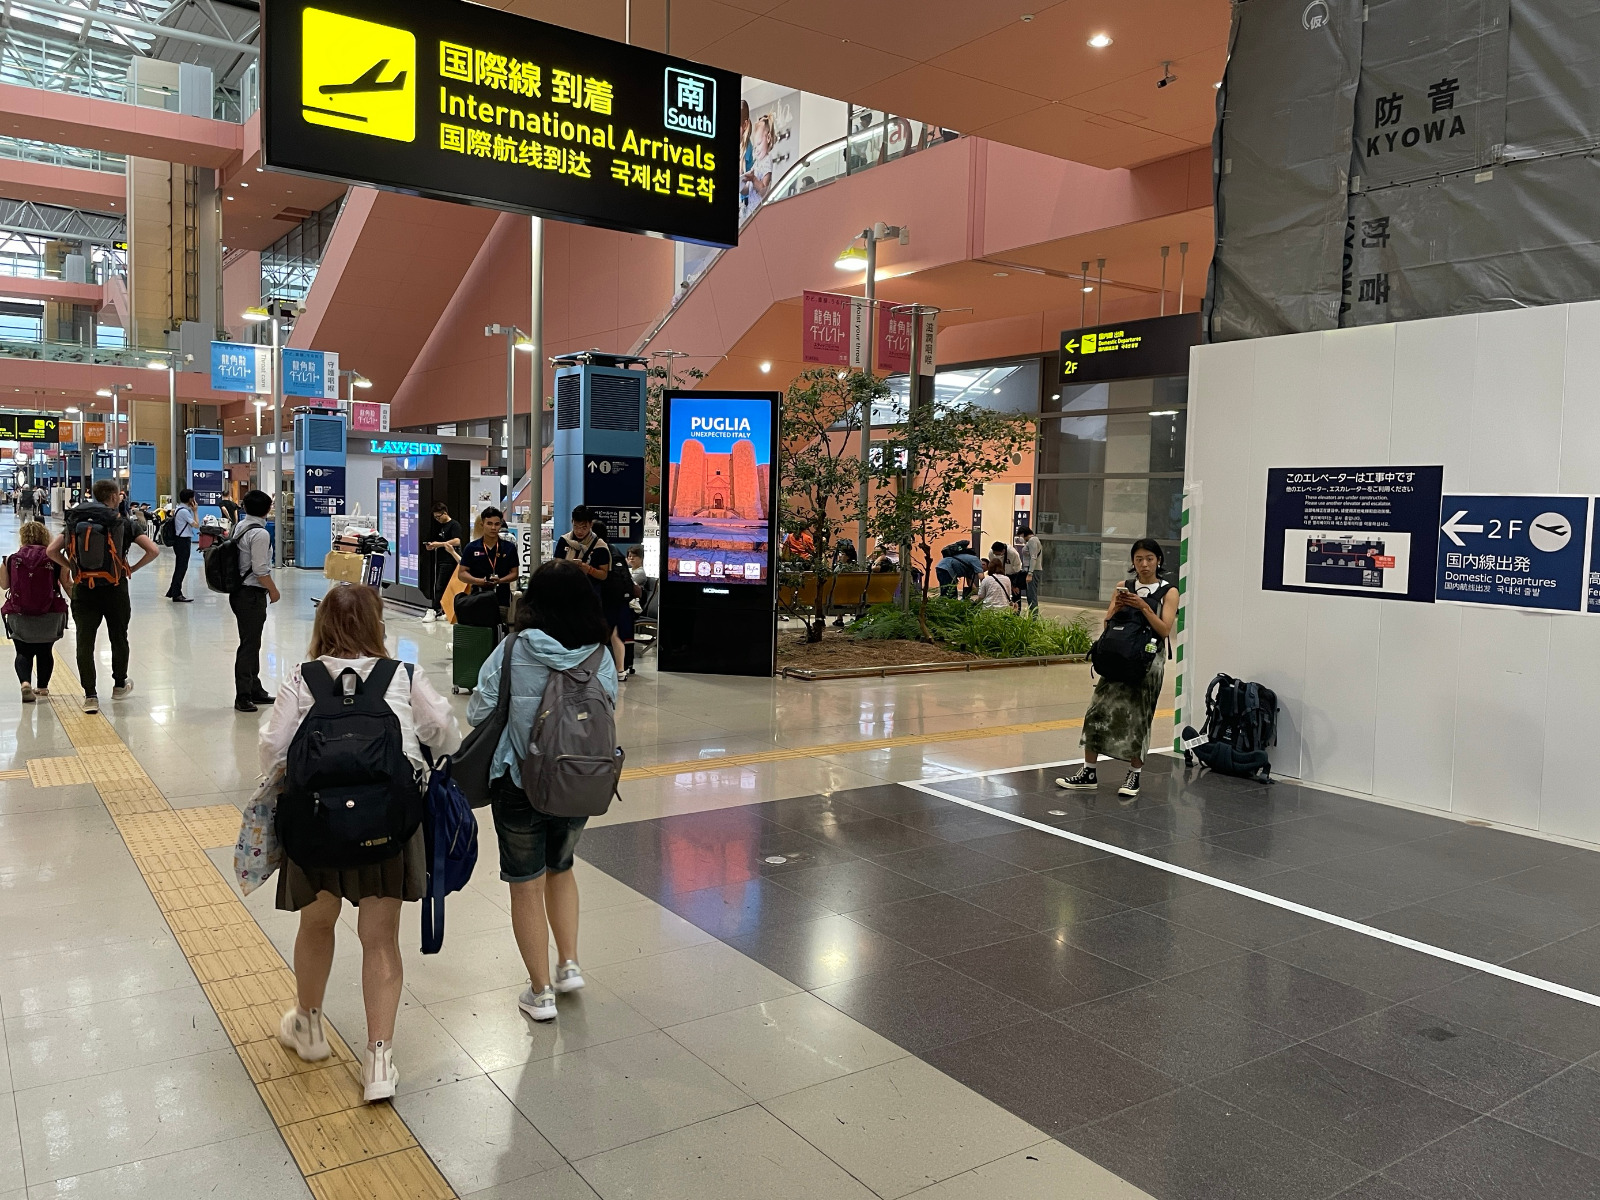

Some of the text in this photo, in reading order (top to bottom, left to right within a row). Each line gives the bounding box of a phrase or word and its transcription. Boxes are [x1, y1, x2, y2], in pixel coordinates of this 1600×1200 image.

[439, 40, 614, 116] 国際線 到着
[677, 75, 706, 110] 南
[439, 87, 716, 172] International Arrivals
[667, 107, 713, 133] South
[1366, 114, 1467, 158] KYOWA
[610, 158, 716, 204] 국제선 도착
[1064, 361, 1078, 374] 2F
[691, 416, 751, 431] PUGLIA
[370, 440, 442, 455] LAWSON
[1286, 472, 1415, 483] このエレベーターは工事中です
[1488, 520, 1522, 539] 2F
[1446, 552, 1531, 572] 国内線出発
[1445, 572, 1556, 588] Domestic Departures
[1496, 586, 1540, 597] 국내선 출발
